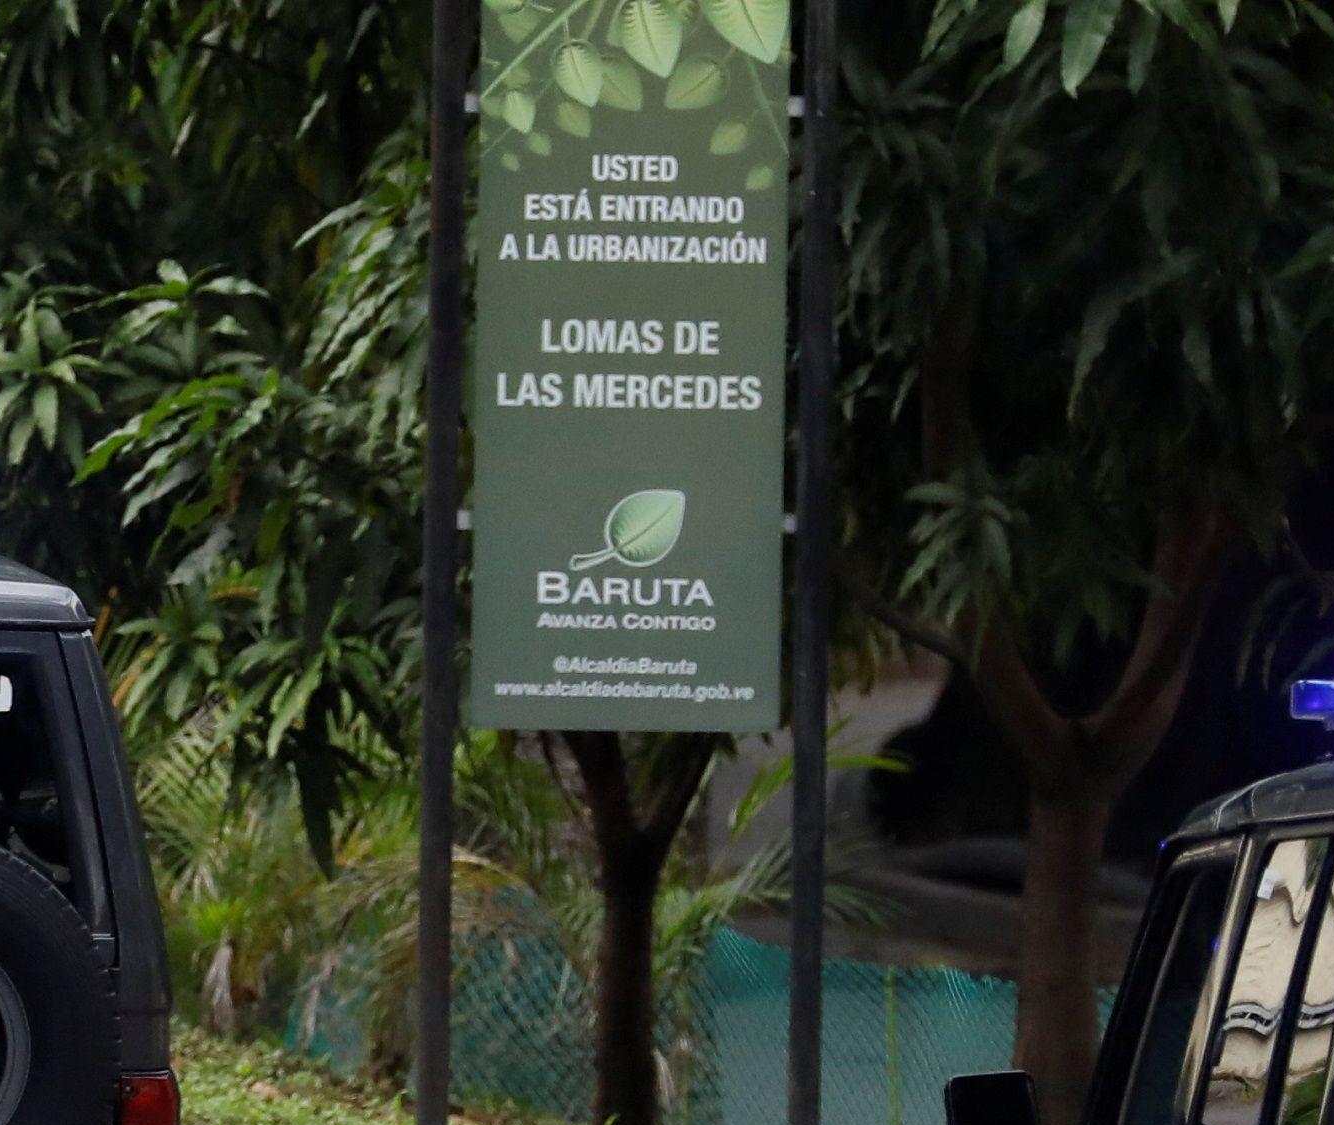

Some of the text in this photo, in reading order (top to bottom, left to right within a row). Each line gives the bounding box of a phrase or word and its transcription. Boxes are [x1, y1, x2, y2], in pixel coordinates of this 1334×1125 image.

[591, 154, 678, 182] USTED
[524, 188, 744, 224] ESTÁ ENTRANDO
[499, 230, 767, 264] A LA URBANIZACIÓN
[540, 318, 720, 355] LOMAS DE
[496, 372, 763, 410] LAS MERCEDES
[536, 570, 715, 606] BARUTA
[535, 612, 716, 631] AVANZA CONTIGO
